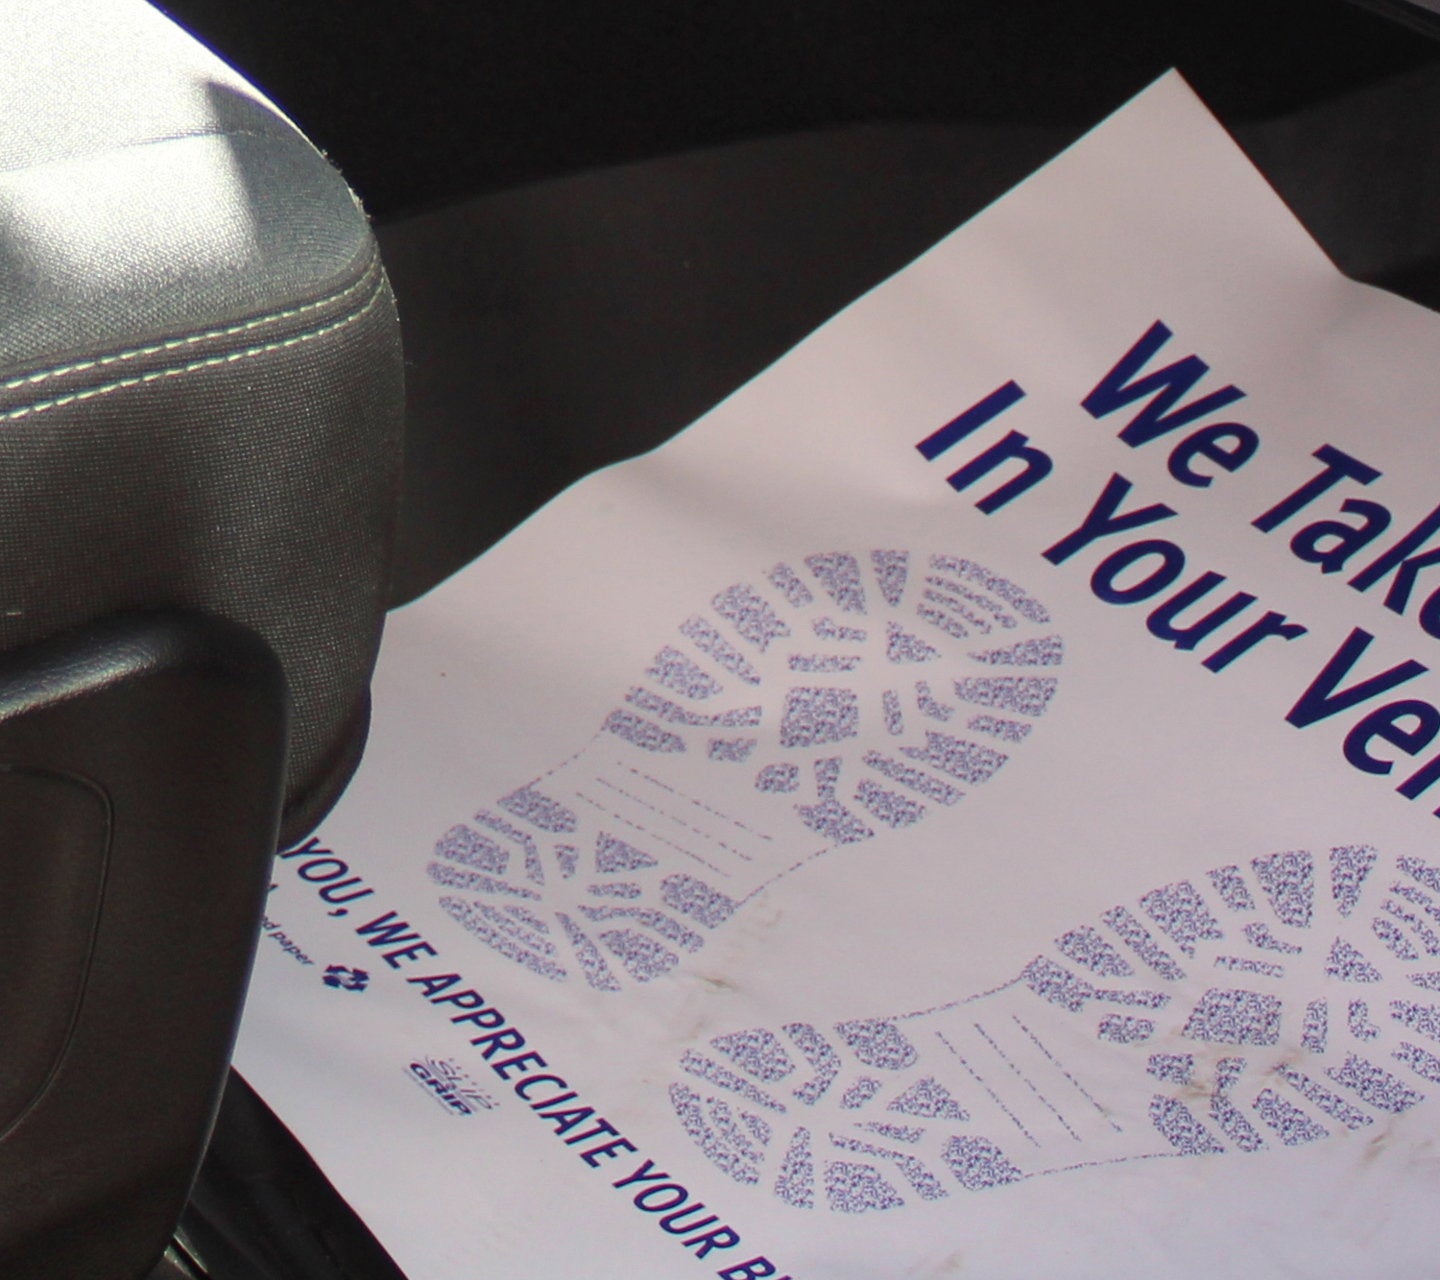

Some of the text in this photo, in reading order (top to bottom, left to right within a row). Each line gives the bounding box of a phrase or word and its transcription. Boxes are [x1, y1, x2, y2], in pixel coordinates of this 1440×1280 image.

[1080, 320, 1260, 488] We
[915, 379, 1053, 514] In
[1042, 472, 1308, 673] Your
[267, 931, 314, 964] paper
[280, 836, 374, 917] YOU,
[355, 910, 438, 970] WE
[406, 973, 639, 1169] APPRECIATE
[612, 1159, 741, 1259] YOUR
[409, 1062, 472, 1115] GRIP
